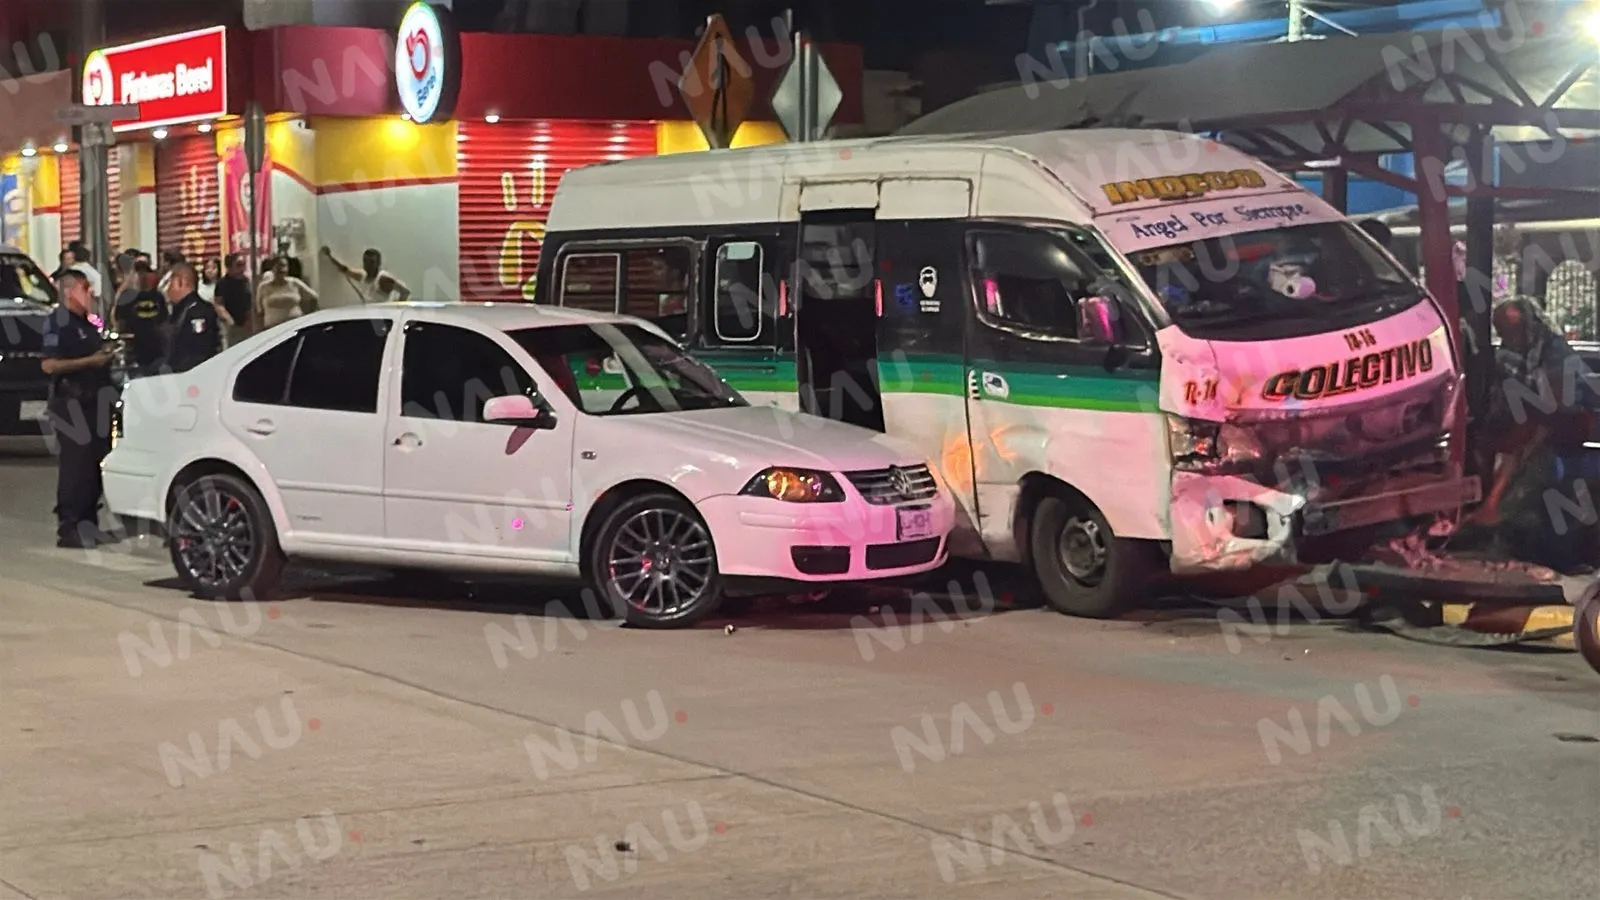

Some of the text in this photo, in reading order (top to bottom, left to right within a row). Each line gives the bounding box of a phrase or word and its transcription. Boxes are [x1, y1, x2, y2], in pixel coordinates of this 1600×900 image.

[1130, 203, 1310, 239] Angel Por Siempre
[1262, 338, 1433, 402] COLECTIVO
